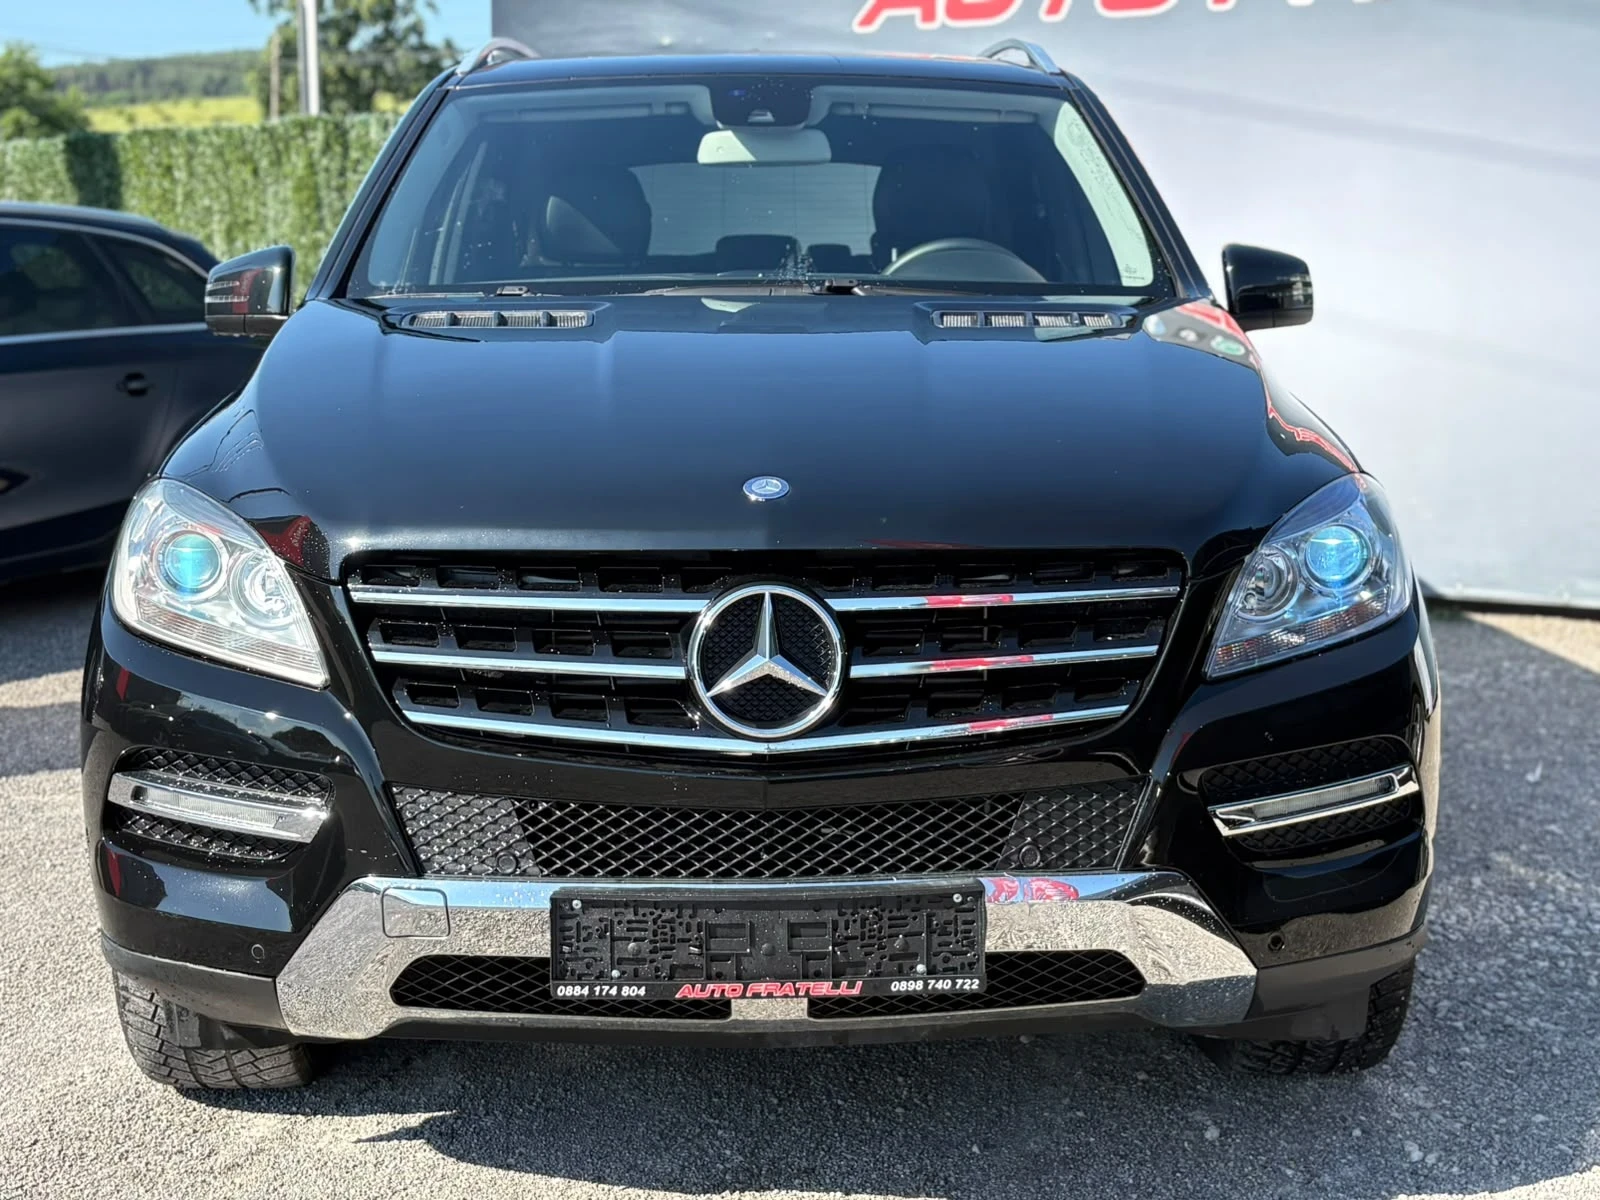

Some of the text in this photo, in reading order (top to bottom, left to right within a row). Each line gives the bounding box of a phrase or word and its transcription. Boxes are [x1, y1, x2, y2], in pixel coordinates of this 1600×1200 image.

[556, 985, 646, 997] 0884 174 804
[675, 981, 864, 998] AUTO FRATELLI
[890, 978, 980, 992] 0898 740 722
